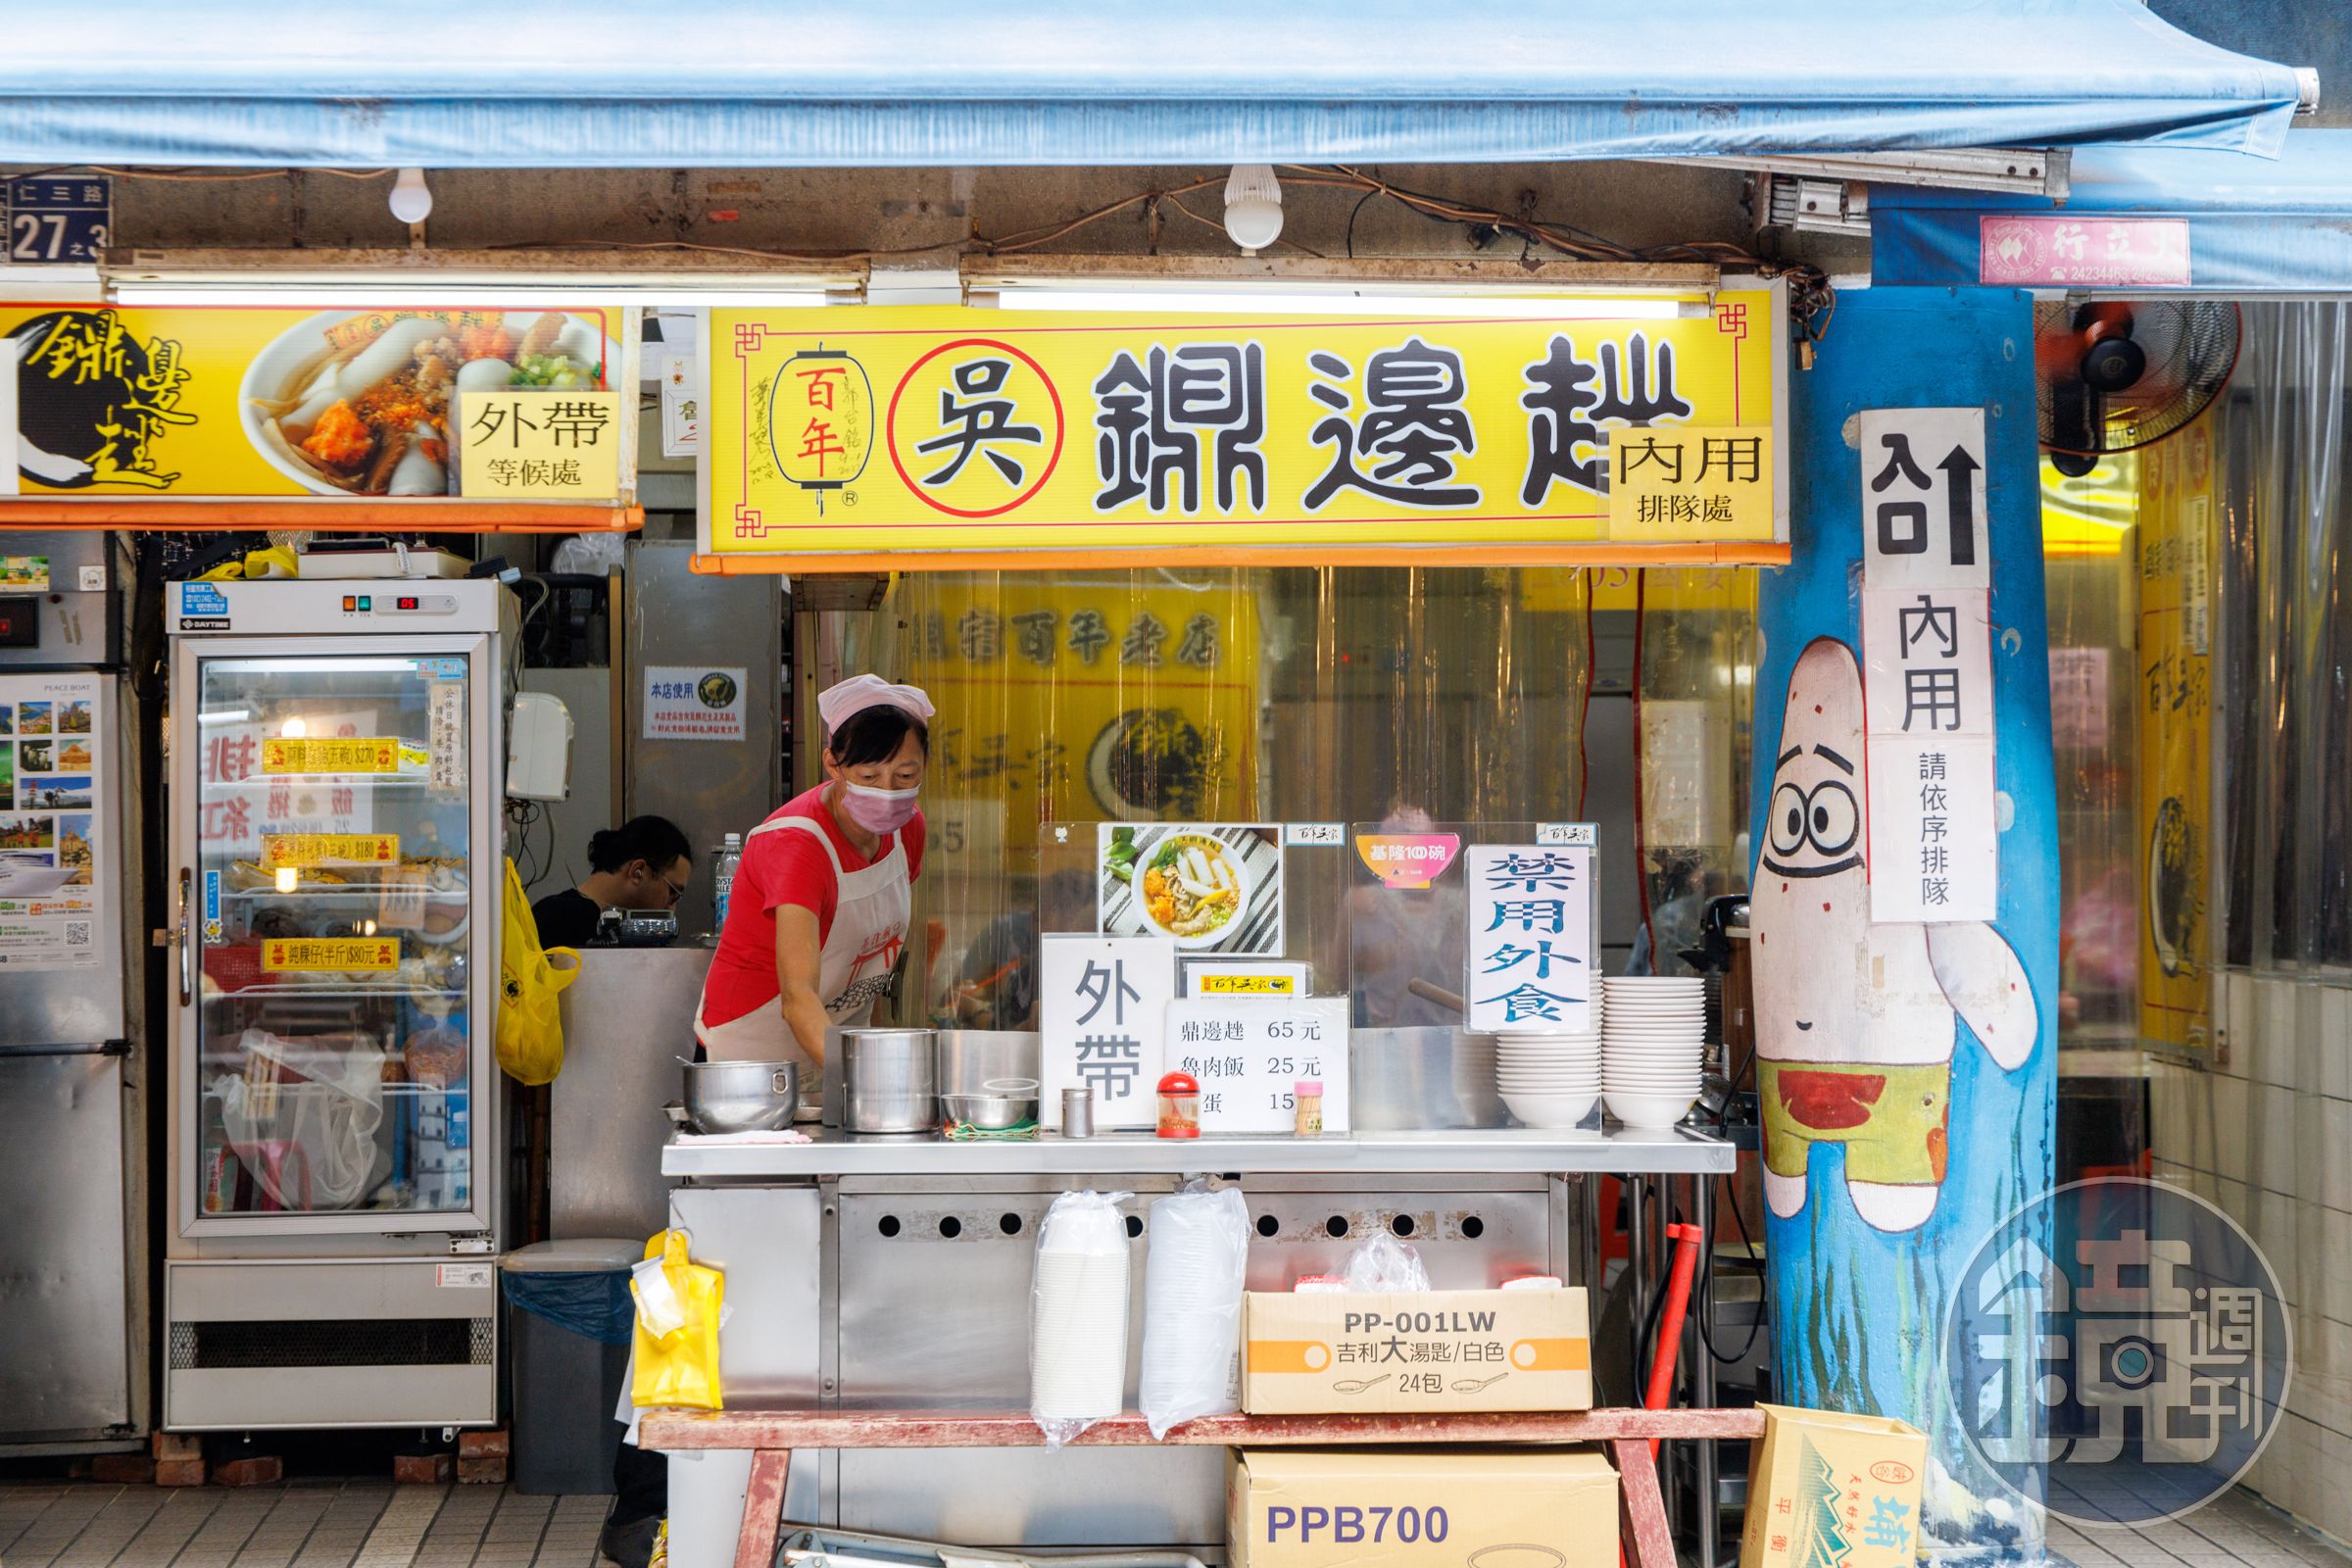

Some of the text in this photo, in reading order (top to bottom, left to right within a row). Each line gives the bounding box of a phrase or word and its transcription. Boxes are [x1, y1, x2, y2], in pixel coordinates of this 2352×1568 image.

[18, 184, 103, 203] 仁三路
[469, 403, 610, 448] 外帶
[796, 367, 847, 478] 百年
[917, 360, 1043, 487] 吳
[486, 459, 581, 487] 等候處
[1620, 436, 1763, 484] 內用
[1871, 432, 1933, 555] 入口
[1637, 494, 1734, 522] 排隊處
[1898, 594, 1961, 732] 內用
[652, 682, 694, 699] 本店使用
[356, 747, 374, 763] $270
[1919, 752, 1949, 906] 請依序排隊
[355, 842, 374, 858] $180
[1370, 845, 1446, 861] 基隆100碗
[1474, 854, 1589, 1022] 禁用外食
[1074, 958, 1142, 1102] 外帶
[1267, 1022, 1295, 1039] 65
[1300, 1022, 1321, 1041] 元
[1267, 1057, 1295, 1074] 25
[1300, 1058, 1321, 1076] 元
[1270, 1093, 1295, 1110] 15
[1345, 1311, 1496, 1333] PP-001LW
[1337, 1336, 1505, 1364] 吉利大湯匙/白色
[1399, 1374, 1443, 1394] 24包
[1267, 1506, 1448, 1544] PPB700
[1770, 1496, 1791, 1552] 平衡
